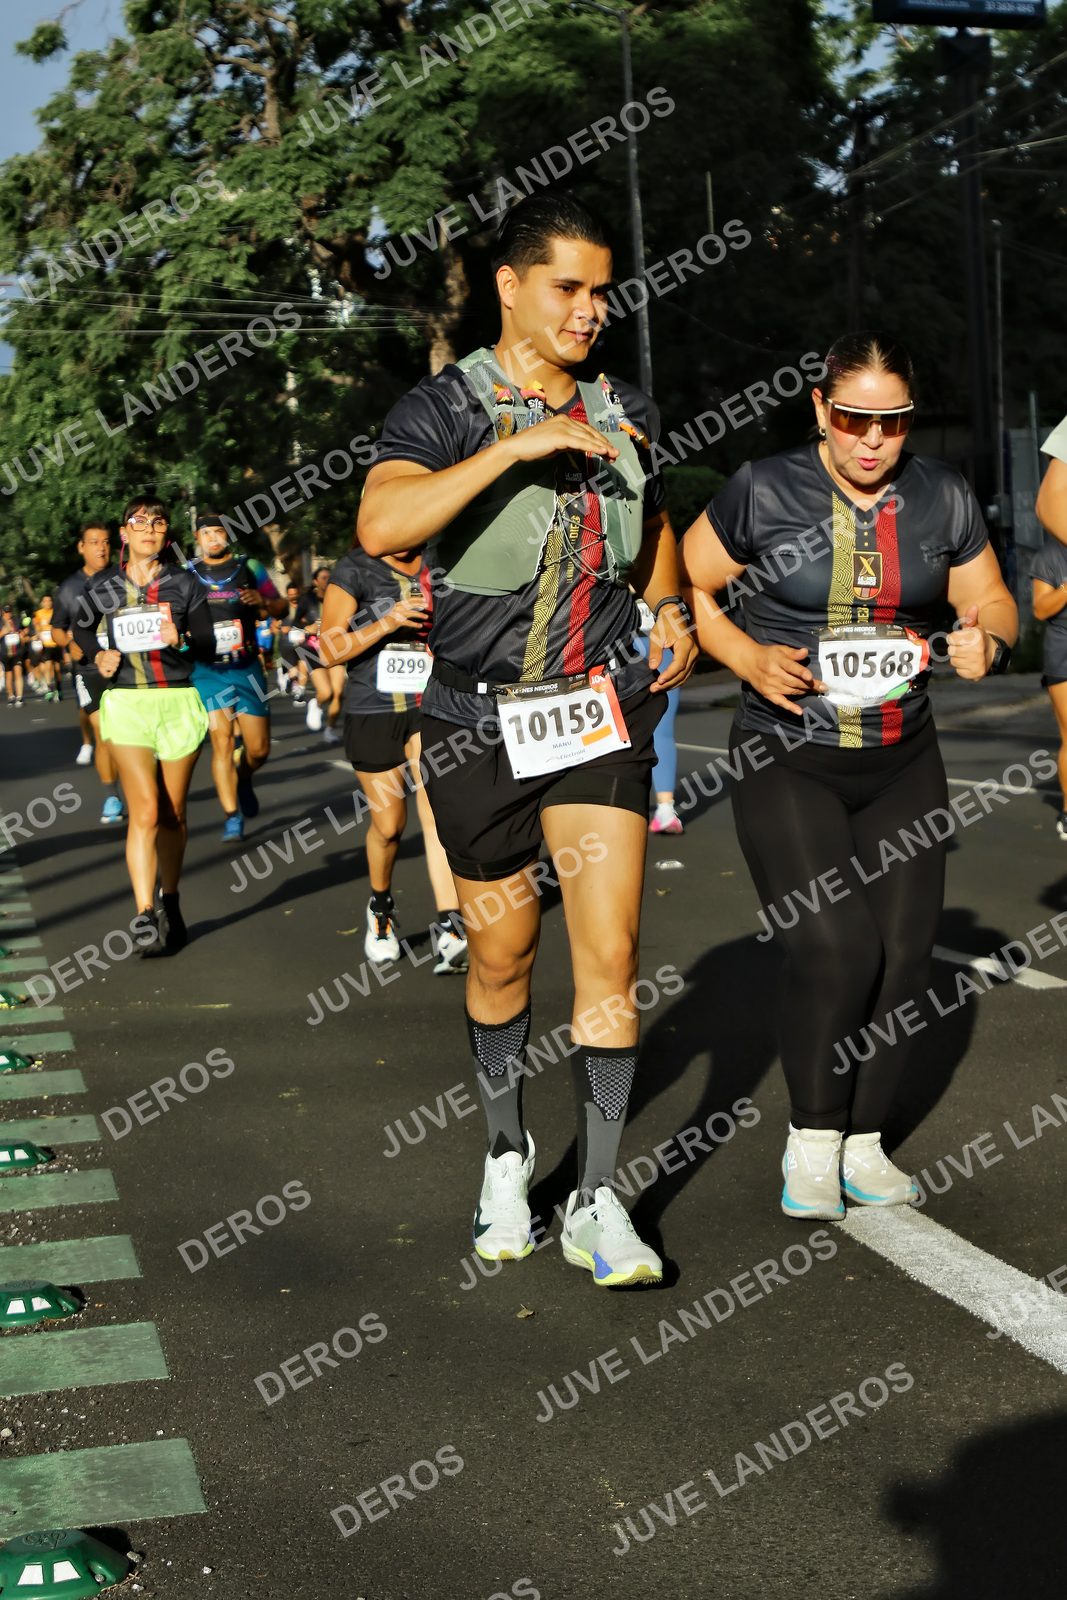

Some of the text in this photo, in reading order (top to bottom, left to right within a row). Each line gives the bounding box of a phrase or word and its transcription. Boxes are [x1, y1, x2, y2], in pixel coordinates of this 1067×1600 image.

[386, 657, 427, 674] 8299
[825, 650, 914, 678] 10568
[508, 699, 605, 744] 10159
[552, 741, 572, 749] MANU
